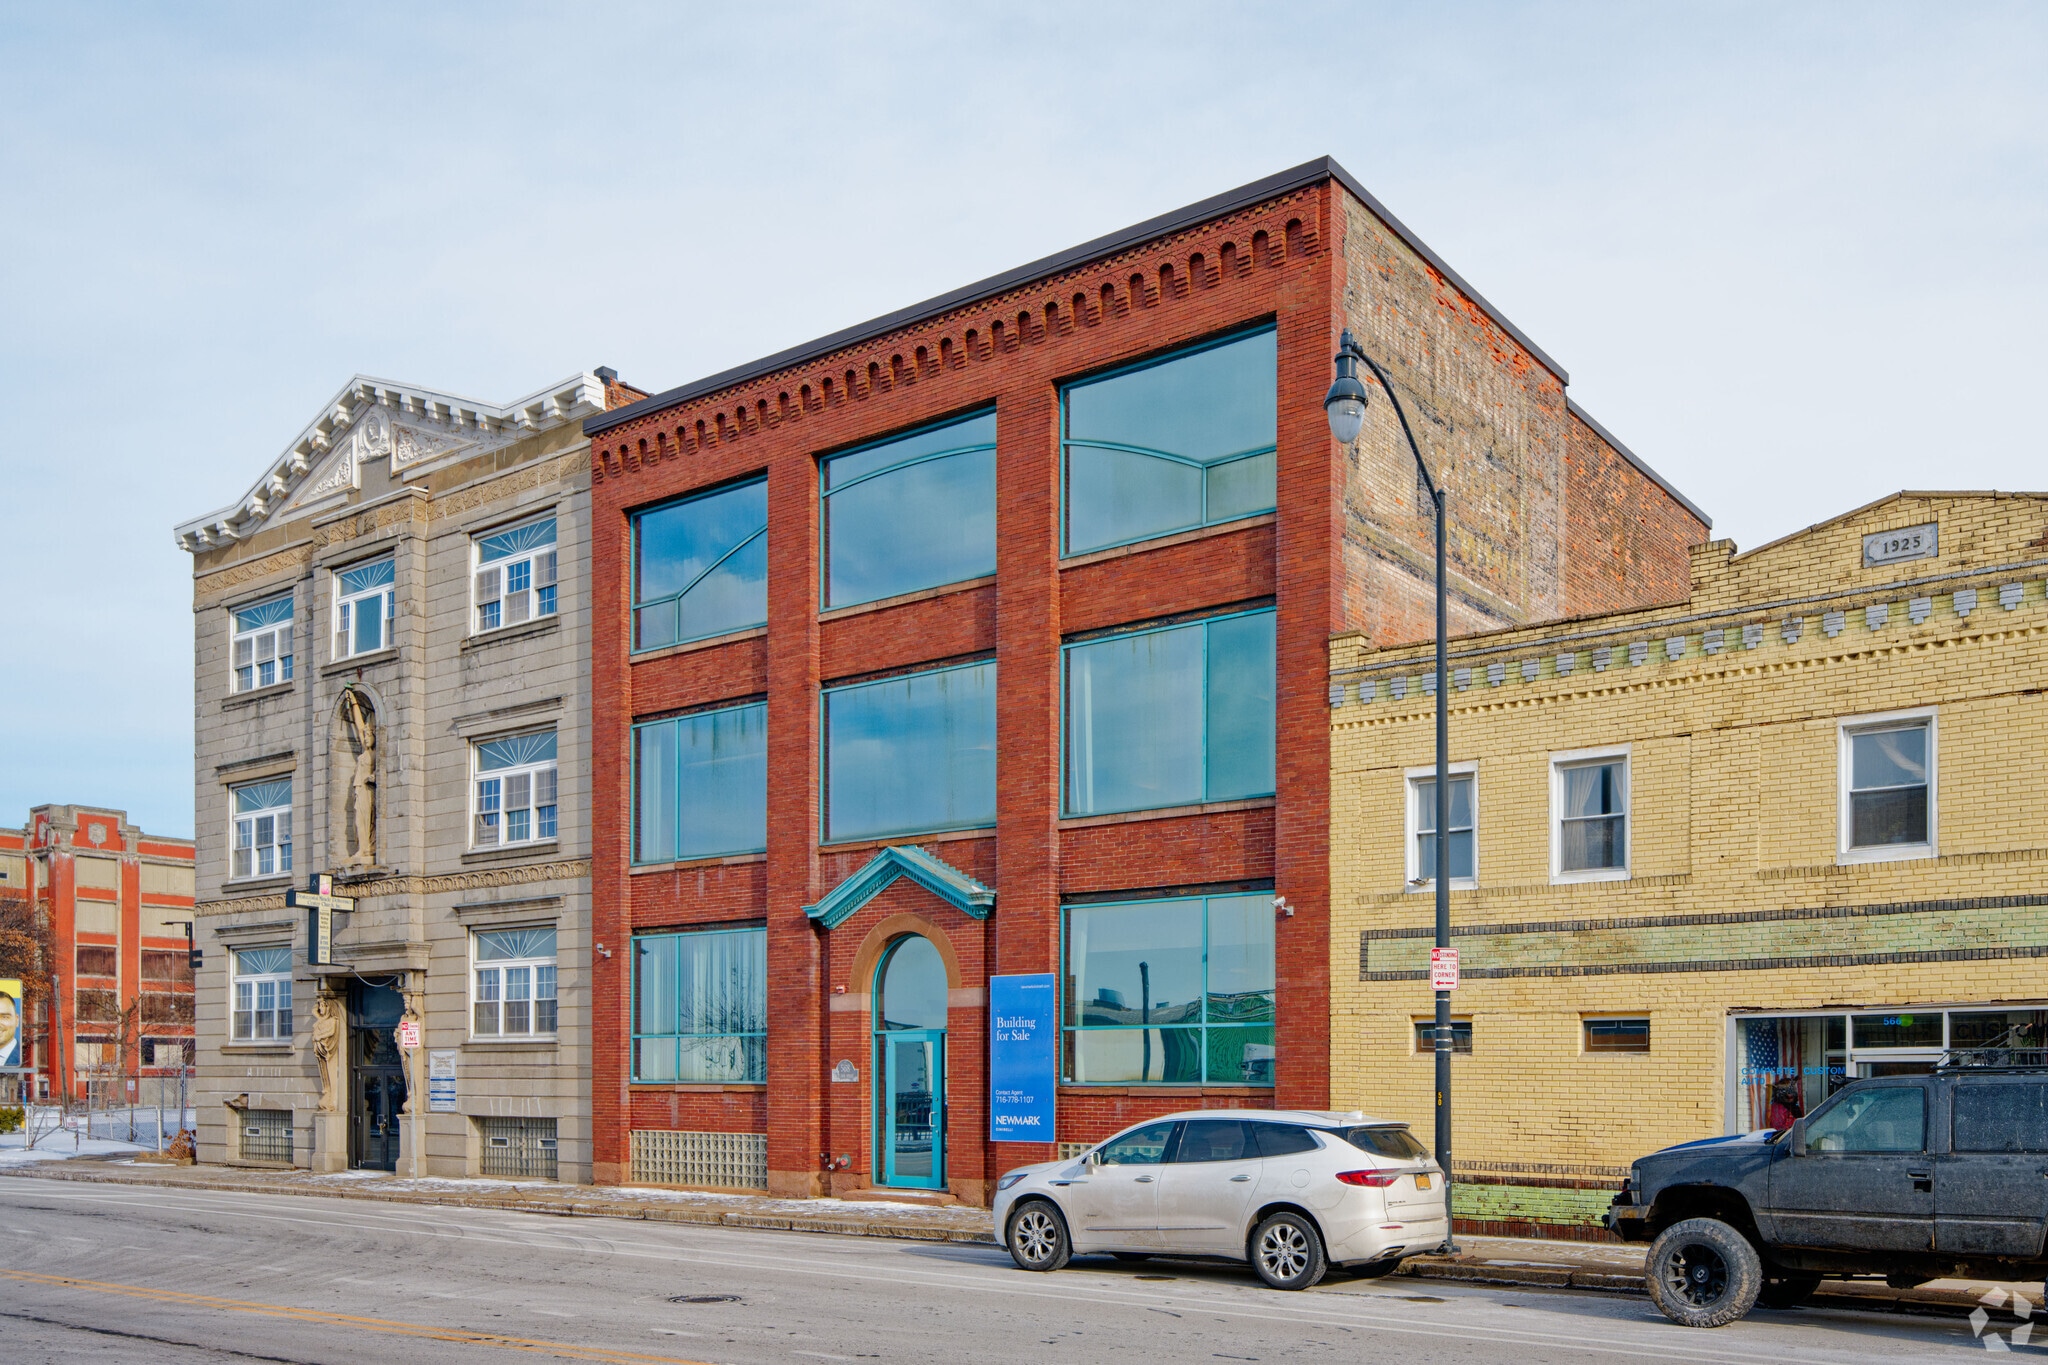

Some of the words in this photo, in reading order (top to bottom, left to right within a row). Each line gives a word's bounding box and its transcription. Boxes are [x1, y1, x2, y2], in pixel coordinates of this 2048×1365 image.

[1883, 535, 1921, 554] 1925
[996, 1017, 1036, 1030] Building
[996, 1030, 1009, 1042] for
[1011, 1029, 1030, 1041] Sale
[1955, 1022, 2048, 1040] CUSTOM
[1741, 1067, 1796, 1076] COMPLETE
[1803, 1067, 1846, 1075] CUSTOM
[1741, 1077, 1766, 1085] AUTO
[995, 1115, 1041, 1126] NEWMARK
